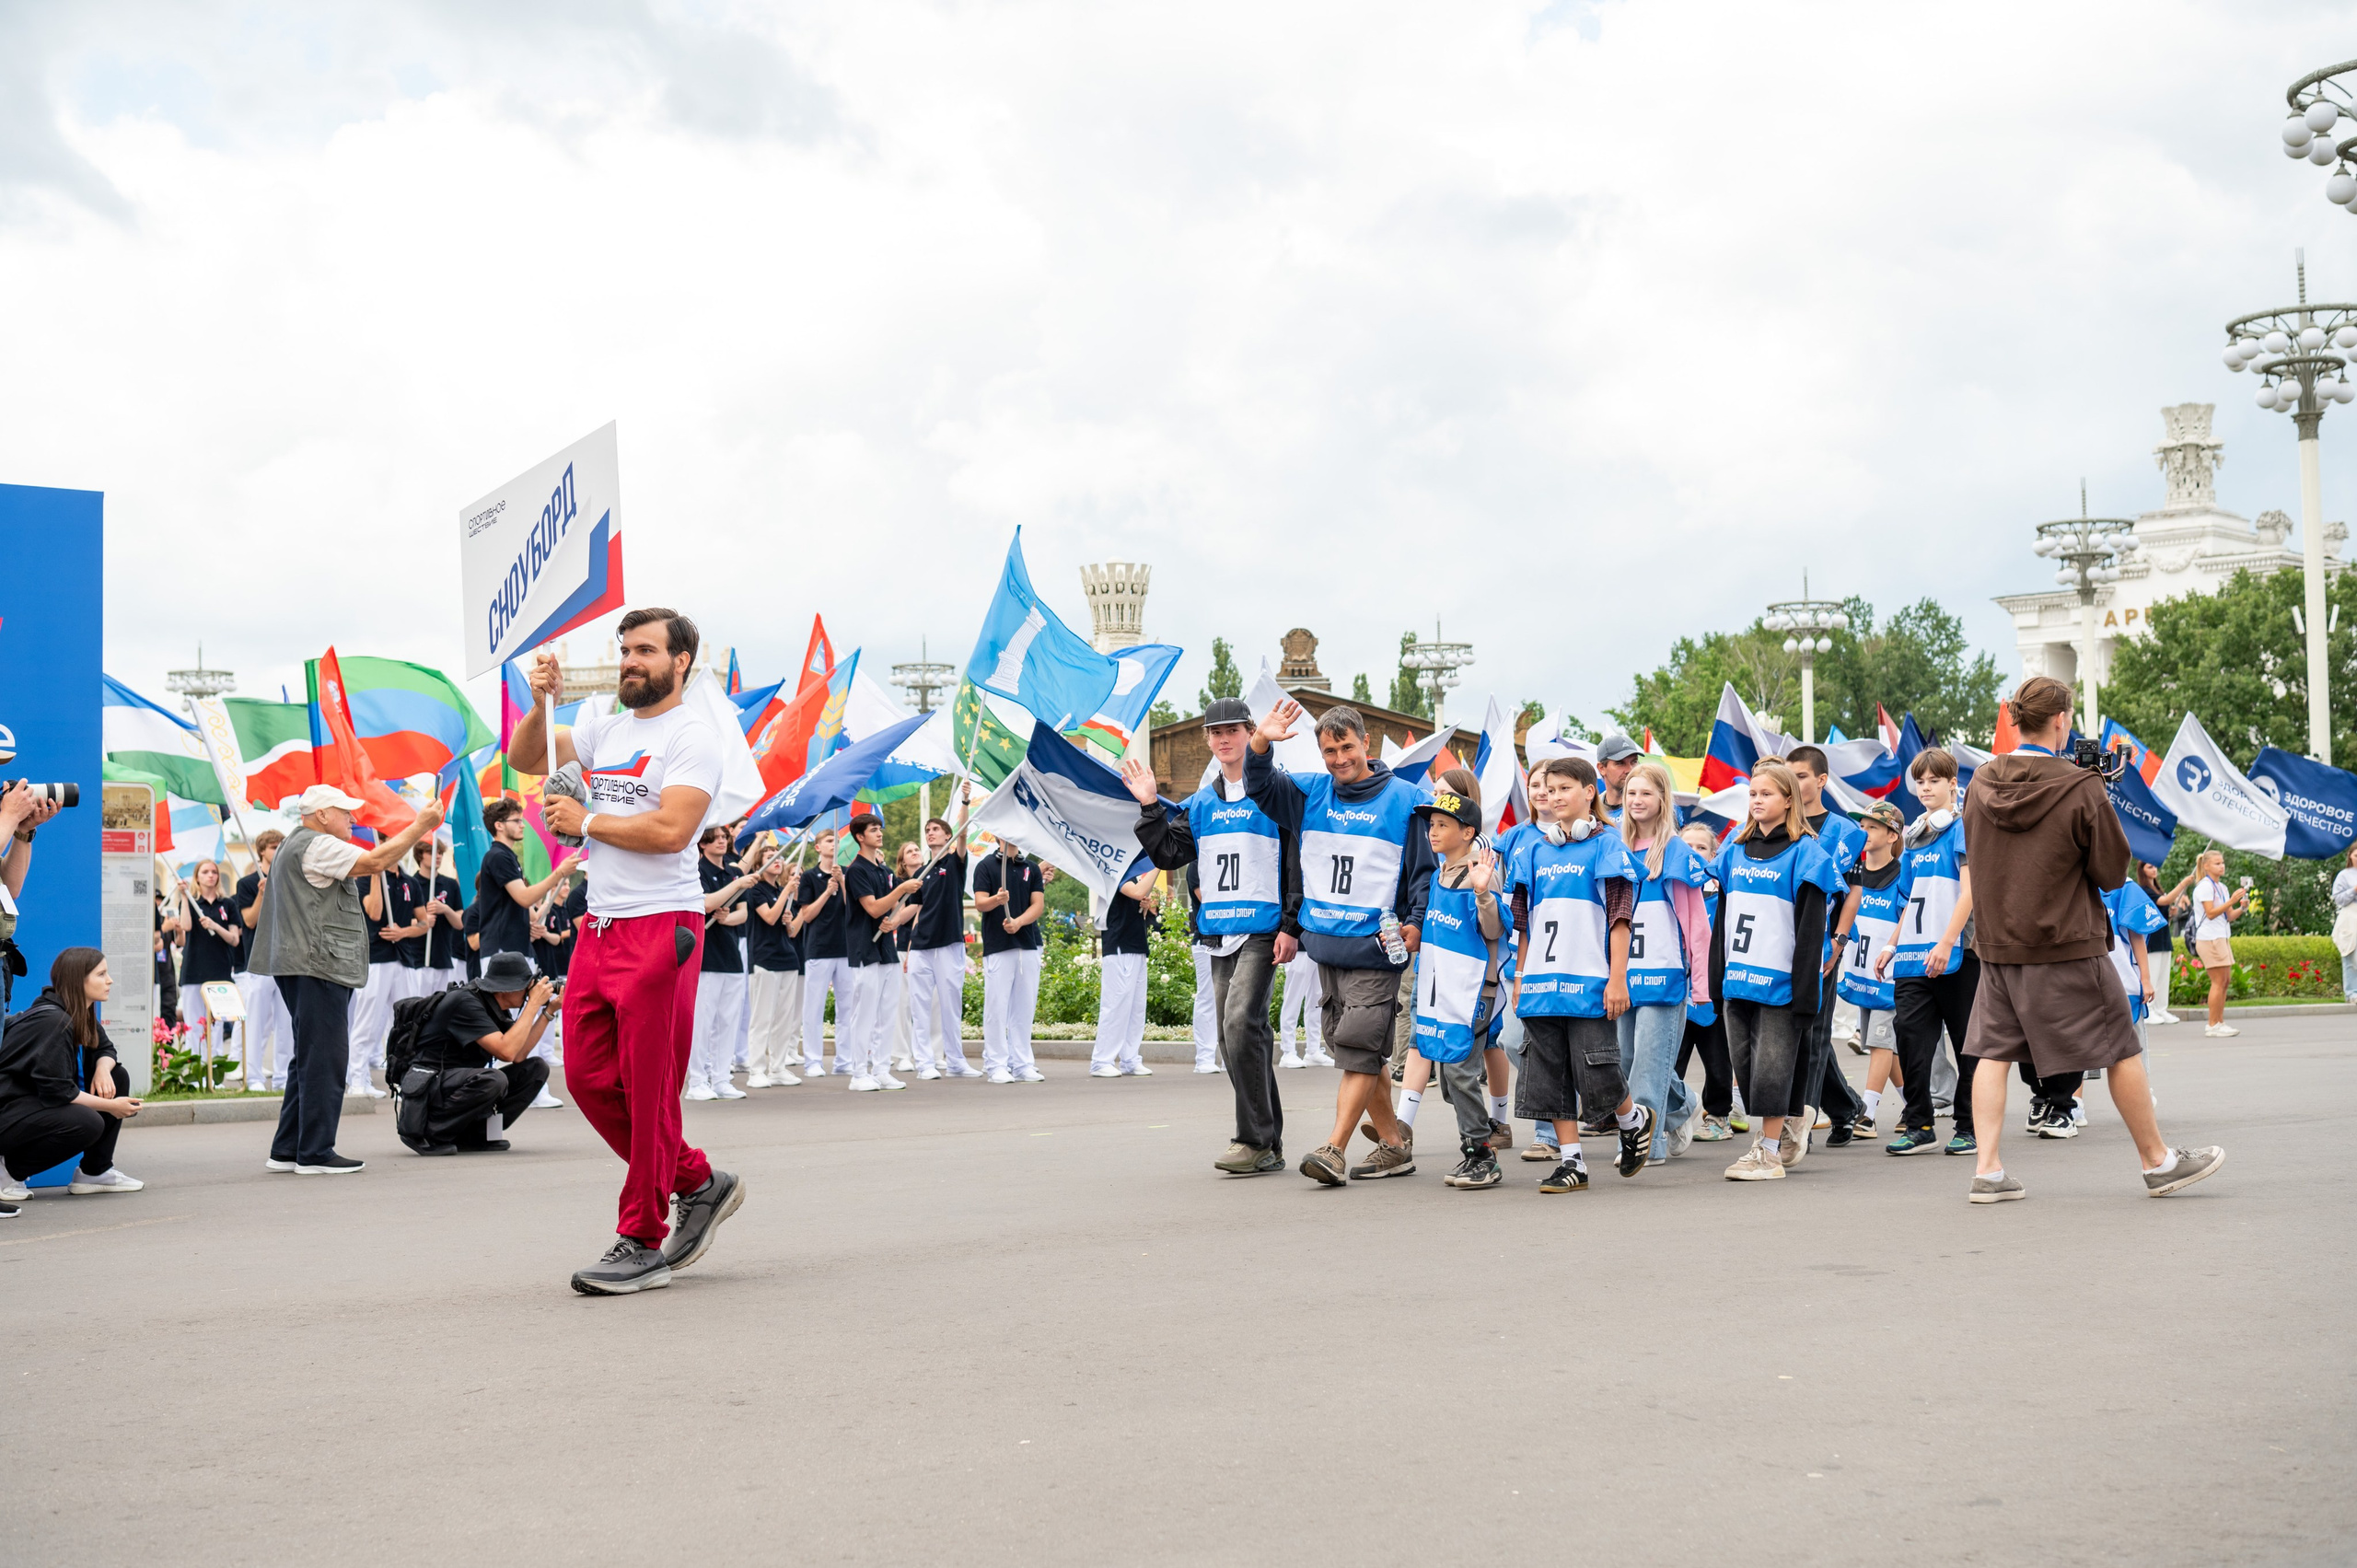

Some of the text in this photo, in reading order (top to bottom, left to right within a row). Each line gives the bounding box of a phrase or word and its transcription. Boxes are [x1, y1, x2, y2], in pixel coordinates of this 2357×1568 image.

[488, 460, 577, 655] СНОУБОРД
[591, 792, 635, 805] ЕСТВИЕ
[2283, 792, 2355, 823] ЗДОРОВОЕ
[1211, 807, 1253, 825] playToday
[1326, 807, 1377, 827] playToday
[2284, 807, 2353, 838] ОТЕЧЕСТВО
[1216, 853, 1240, 892] 20
[1331, 854, 1354, 895] 18
[1732, 865, 1782, 884] playToday
[1236, 908, 1256, 918] СПОРТ
[1344, 912, 1369, 923] СПОРТ
[1910, 897, 1925, 935] 7
[1545, 920, 1559, 963] 2
[1732, 912, 1756, 954] 5
[1559, 981, 1585, 994] СПОРТ
[1643, 975, 1666, 985] СПОРТ
[1747, 972, 1773, 987] СПОРТ
